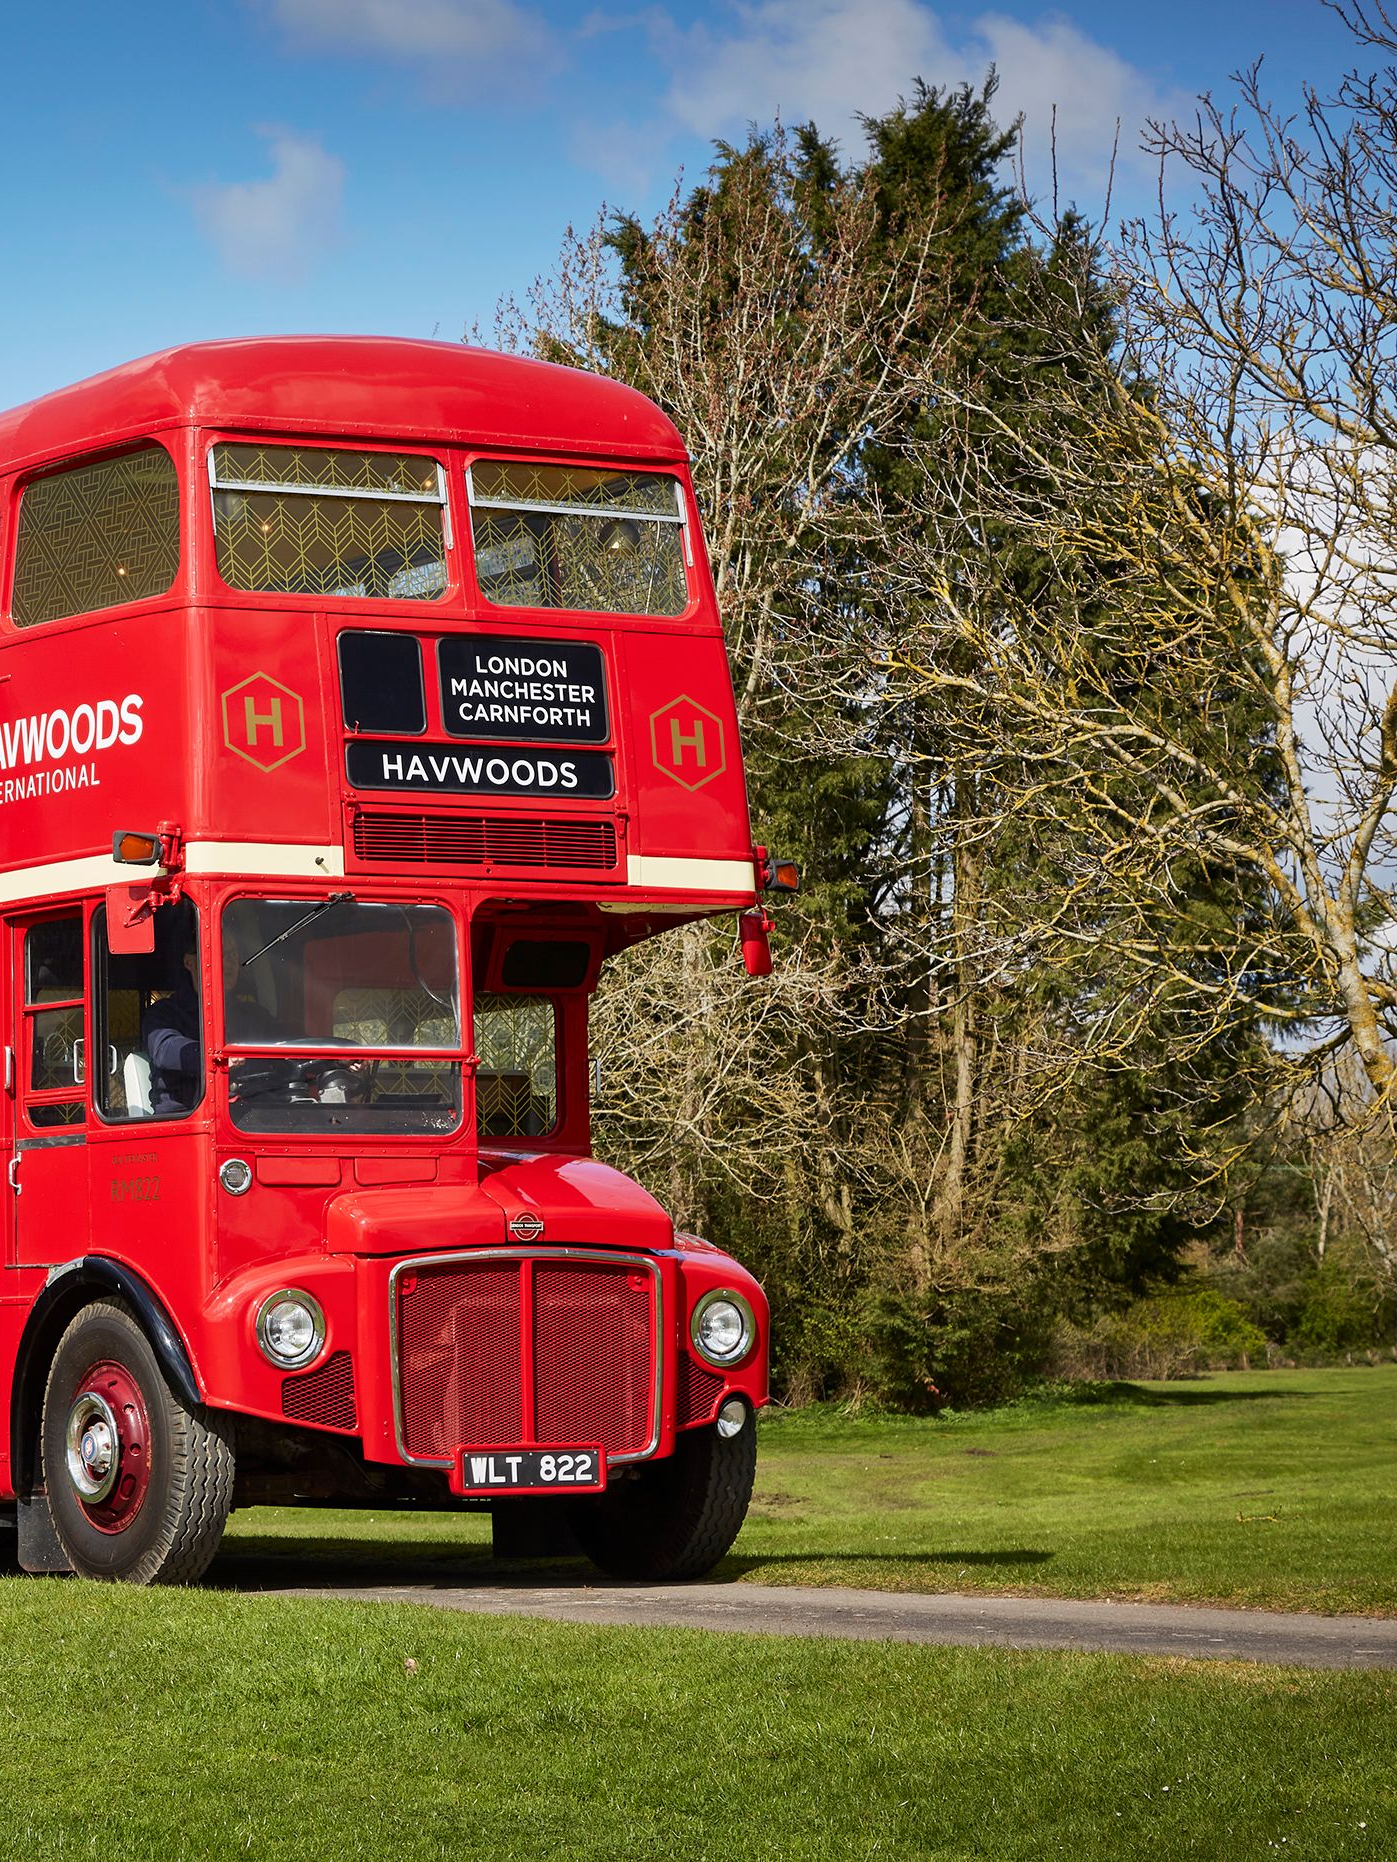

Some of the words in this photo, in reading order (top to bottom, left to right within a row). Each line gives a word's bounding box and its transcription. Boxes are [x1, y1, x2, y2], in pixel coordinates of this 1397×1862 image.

[475, 655, 568, 678] LONDON
[450, 678, 596, 704] MANCHESTER
[244, 696, 284, 747] H
[458, 702, 591, 727] CARNFORTH
[670, 718, 707, 768] H
[382, 753, 578, 788] HAVWOODS
[111, 1175, 161, 1204] RM822
[470, 1456, 523, 1484] WLT
[539, 1454, 593, 1482] 822
